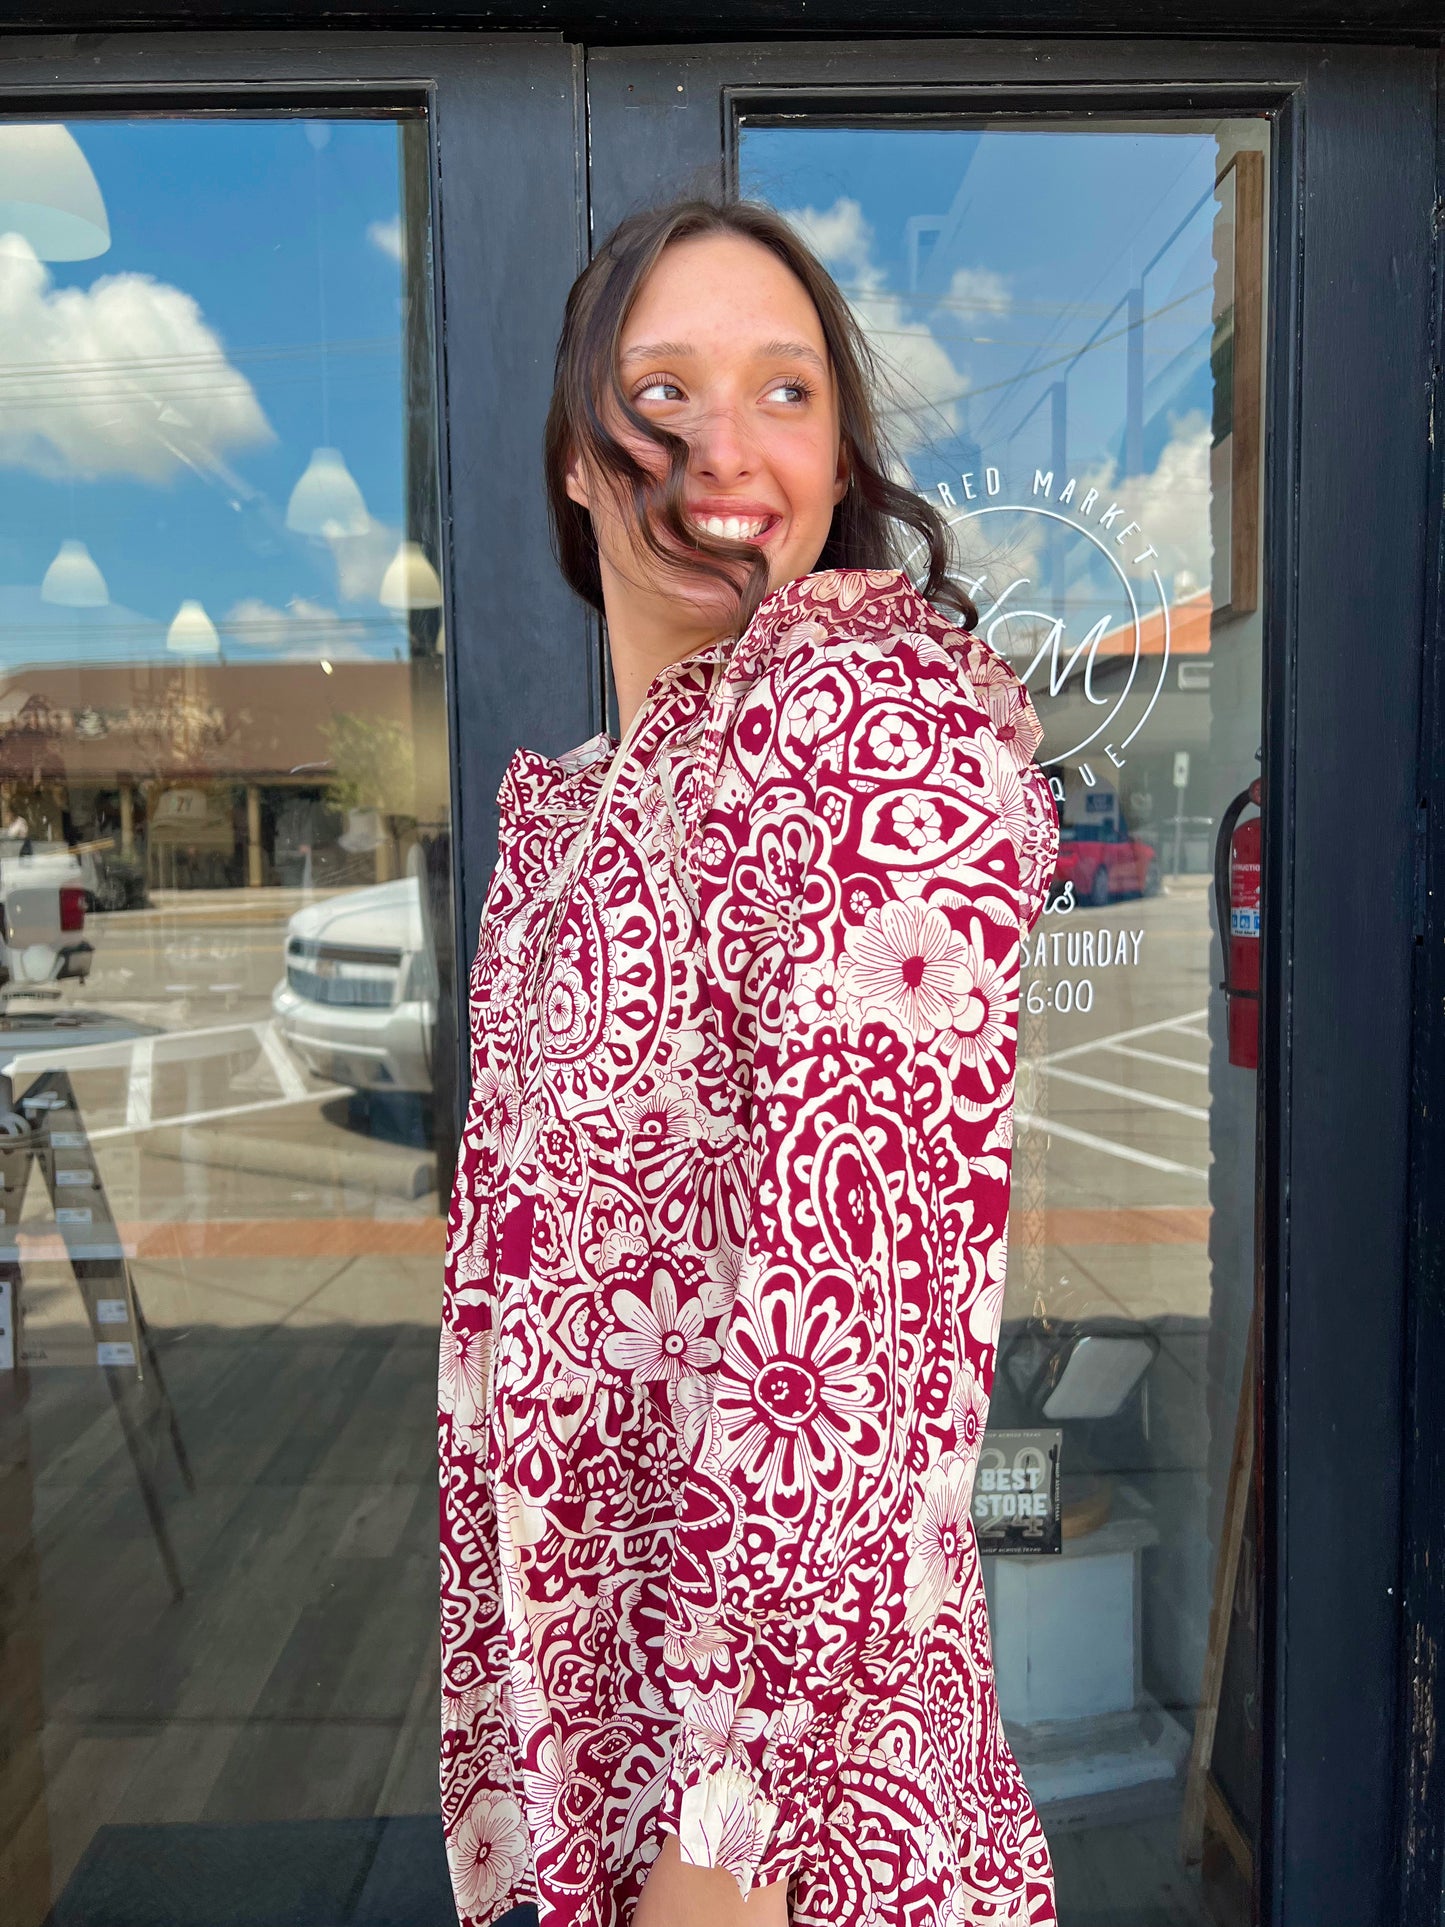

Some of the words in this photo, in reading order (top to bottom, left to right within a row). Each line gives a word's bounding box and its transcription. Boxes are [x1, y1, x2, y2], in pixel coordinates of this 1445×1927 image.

[930, 467, 1000, 509] RED
[1033, 469, 1158, 565] MARKET
[1048, 743, 1126, 803] QUE
[1020, 929, 1144, 968] SATURDAY
[981, 1468, 1041, 1491] BEST
[974, 1493, 1048, 1517] STORE
